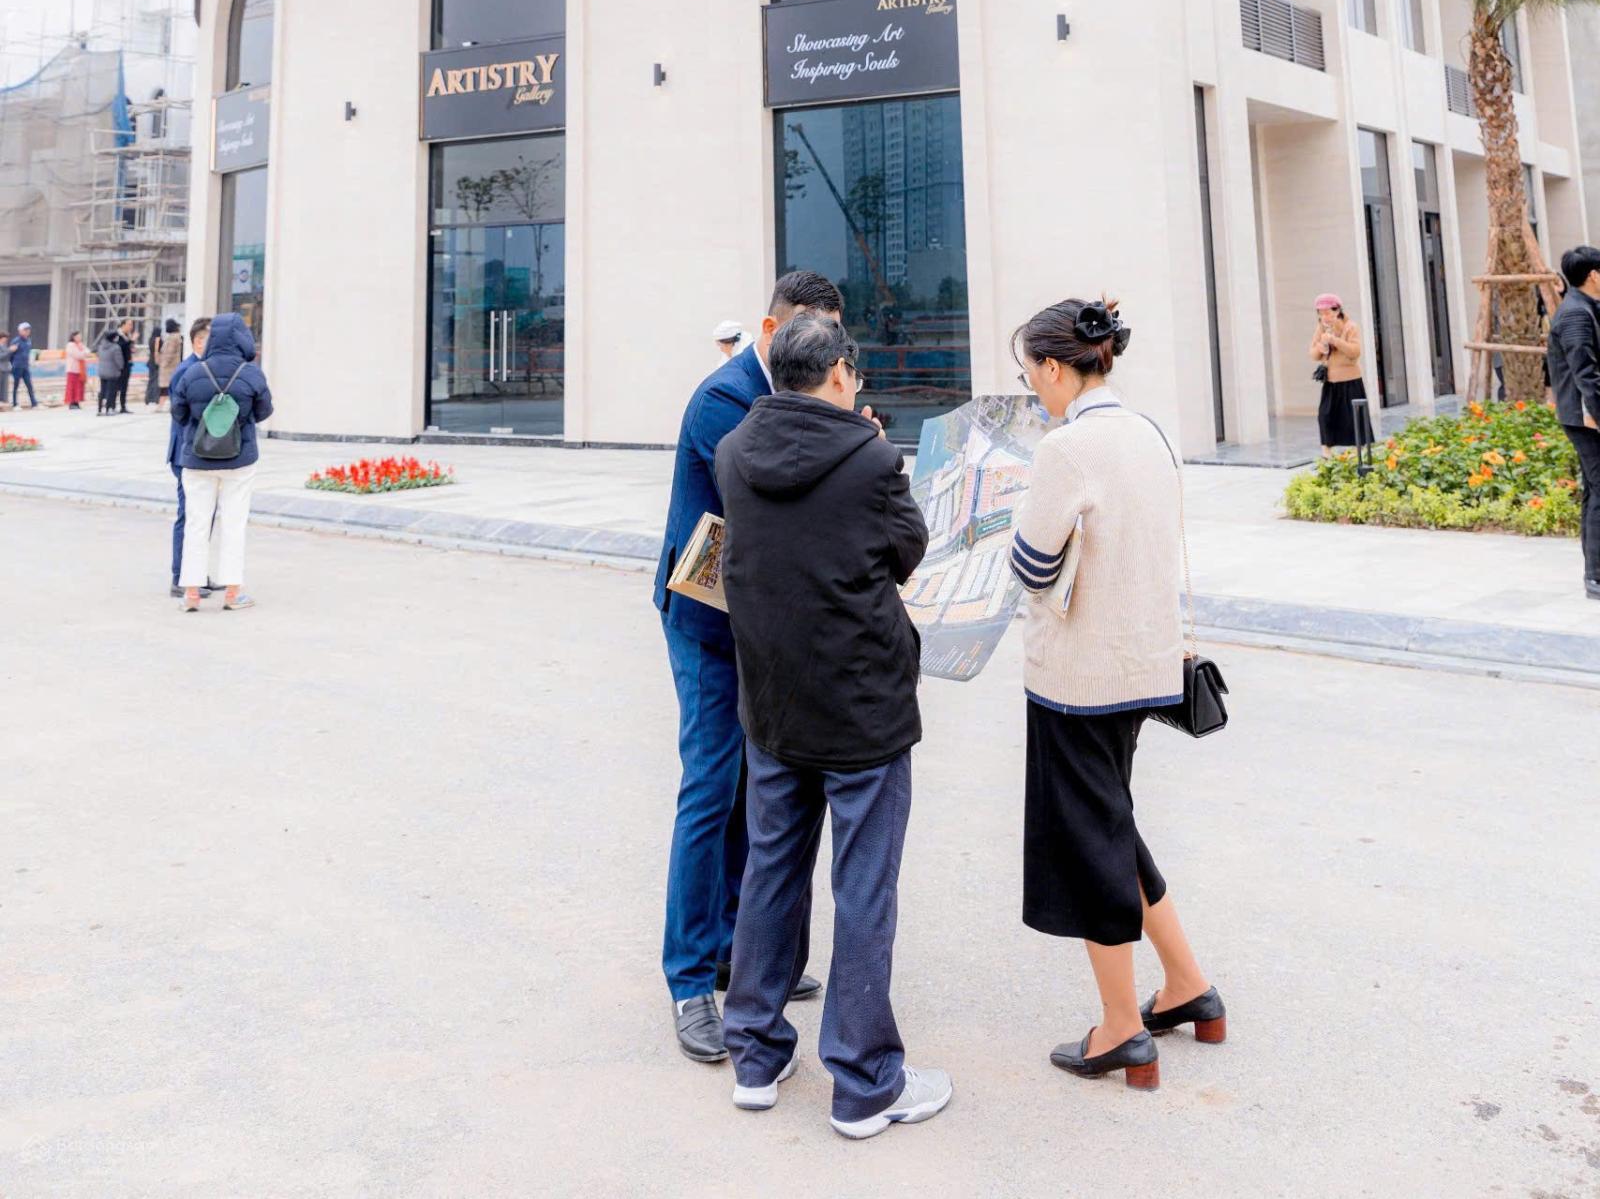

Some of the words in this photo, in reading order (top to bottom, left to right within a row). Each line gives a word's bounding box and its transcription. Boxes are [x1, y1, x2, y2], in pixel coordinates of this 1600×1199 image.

[787, 33, 870, 53] Showcasing
[873, 23, 905, 43] Art
[426, 53, 560, 97] ARTISTRY
[790, 58, 857, 84] Inspiring
[858, 50, 900, 72] Souls
[513, 85, 555, 105] Gallery
